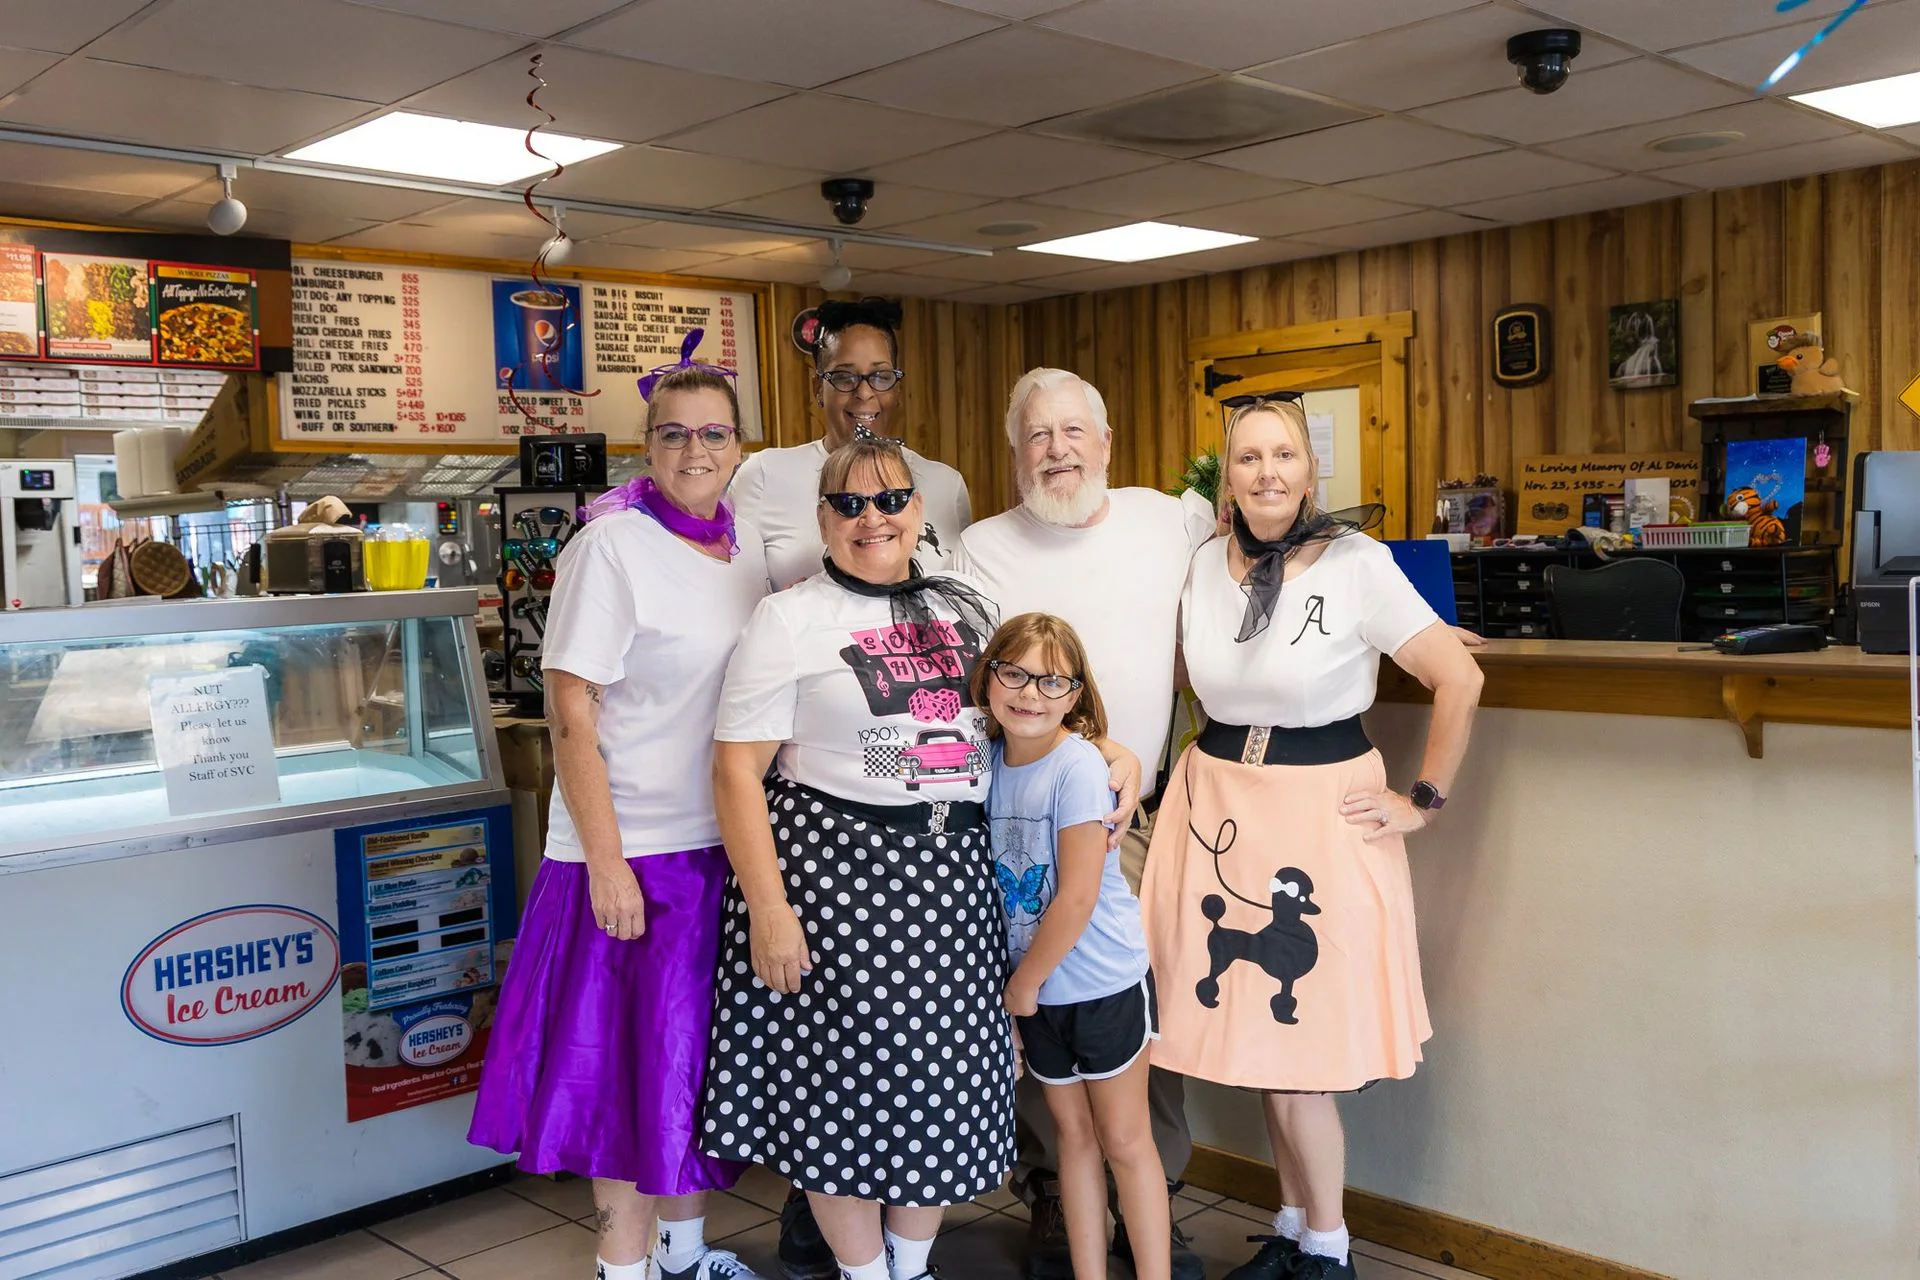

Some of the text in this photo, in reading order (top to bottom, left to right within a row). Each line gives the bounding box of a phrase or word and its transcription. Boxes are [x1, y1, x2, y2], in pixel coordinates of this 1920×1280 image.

[291, 265, 306, 277] BL
[313, 267, 384, 281] CHEESEBURGER
[291, 278, 346, 290] AMBURGER
[290, 289, 308, 300] OT
[310, 290, 329, 301] DOG
[357, 293, 396, 305] TOPPING
[402, 296, 420, 306] 325
[611, 288, 627, 299] BIG
[635, 290, 663, 301] BISCUIT
[292, 301, 420, 318] HILI DOG 325
[611, 301, 628, 311] BIG
[631, 302, 664, 313] COUNTRY
[668, 304, 684, 314] HAM
[686, 306, 711, 316] BISCUIT
[292, 314, 327, 325] RENCH
[334, 315, 360, 327] FRIES
[593, 311, 628, 321] SAUSAGE
[633, 313, 647, 322] EGG
[650, 314, 677, 324] CHEESE
[681, 316, 708, 326] BISCUIT
[292, 326, 422, 341] ACON CHEDDAR FRIES 555
[594, 321, 620, 331] BACON
[624, 323, 638, 332] EGG
[642, 324, 669, 334] CHEESE
[674, 326, 692, 335] BISC
[594, 332, 629, 342] CHICKEN
[636, 334, 665, 344] BISCUIT
[319, 339, 355, 350] CHEESE
[361, 340, 389, 351] FRIES
[403, 343, 423, 353] 470
[595, 342, 629, 352] SAUSAGE
[633, 344, 657, 354] GRAVY
[660, 345, 682, 355] BISCU
[337, 351, 379, 362] TENDERS
[596, 353, 636, 363] PANCAKES
[330, 363, 355, 373] PORK
[358, 364, 402, 374] SANDWICH
[596, 363, 643, 374] HASHBROWN
[291, 374, 330, 384] NACHOS
[291, 386, 352, 397] MOZZARELLA
[356, 387, 387, 397] STICKS
[293, 398, 321, 408] FRIED
[327, 399, 367, 409] PICKLES
[498, 396, 512, 405] ICE
[568, 398, 582, 407] TEA
[294, 409, 321, 420] WING
[327, 410, 356, 420] BITES
[332, 422, 345, 432] OR
[1524, 464, 1536, 472] In
[1540, 463, 1577, 474] Loving
[1580, 462, 1626, 474] Memory
[1630, 461, 1645, 472] Of
[1524, 480, 1547, 490] Nov.
[1573, 481, 1604, 490] 1935
[1290, 594, 1331, 646] A
[889, 655, 957, 677] HOP
[192, 684, 223, 696] NUT
[170, 698, 250, 714] ALLERGY???
[180, 718, 247, 732] Please let us
[202, 734, 231, 746] know
[857, 725, 900, 744] 1950'S
[192, 752, 250, 765] Thank you
[189, 765, 256, 782] Staff of SVC
[154, 930, 314, 992] HERSHEY'S
[167, 981, 311, 1025] Ice Cream
[408, 1023, 464, 1048] HERSHEY'S
[413, 1042, 461, 1059] Ice Cream
[372, 1084, 386, 1094] Real
[422, 1072, 436, 1081] Real
